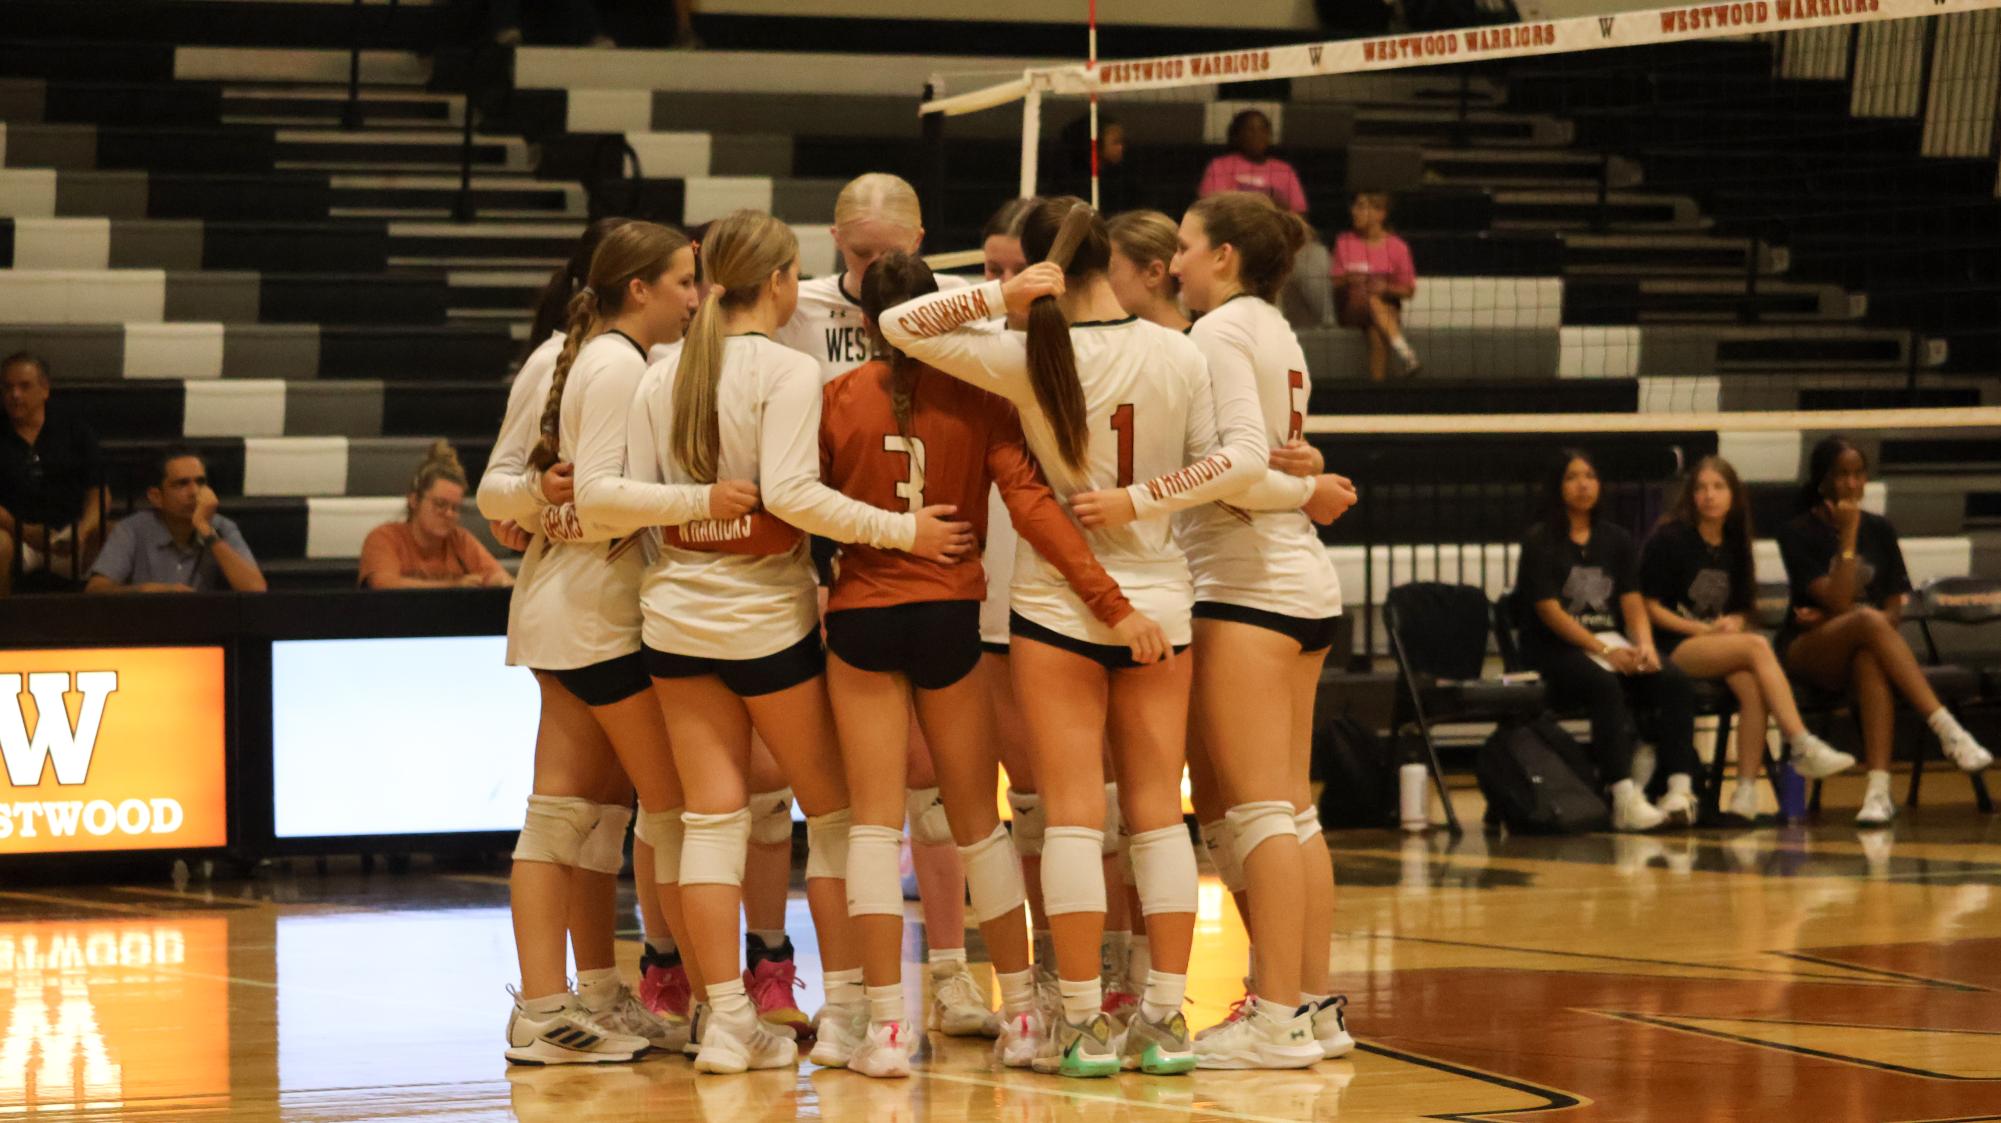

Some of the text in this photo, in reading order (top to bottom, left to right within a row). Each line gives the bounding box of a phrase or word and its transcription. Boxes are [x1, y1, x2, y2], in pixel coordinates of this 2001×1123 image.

[1600, 17, 1614, 38] W
[1661, 2, 1767, 33] WESTWOOD
[1309, 46, 1323, 66] W
[1364, 24, 1555, 62] WESTWOOD WARRIORS
[1101, 52, 1269, 83] WESTWOOD WARRIORS
[1110, 404, 1134, 488] 1
[882, 434, 925, 513] 3
[1146, 453, 1232, 501] WARRIORS
[0, 670, 119, 787] W
